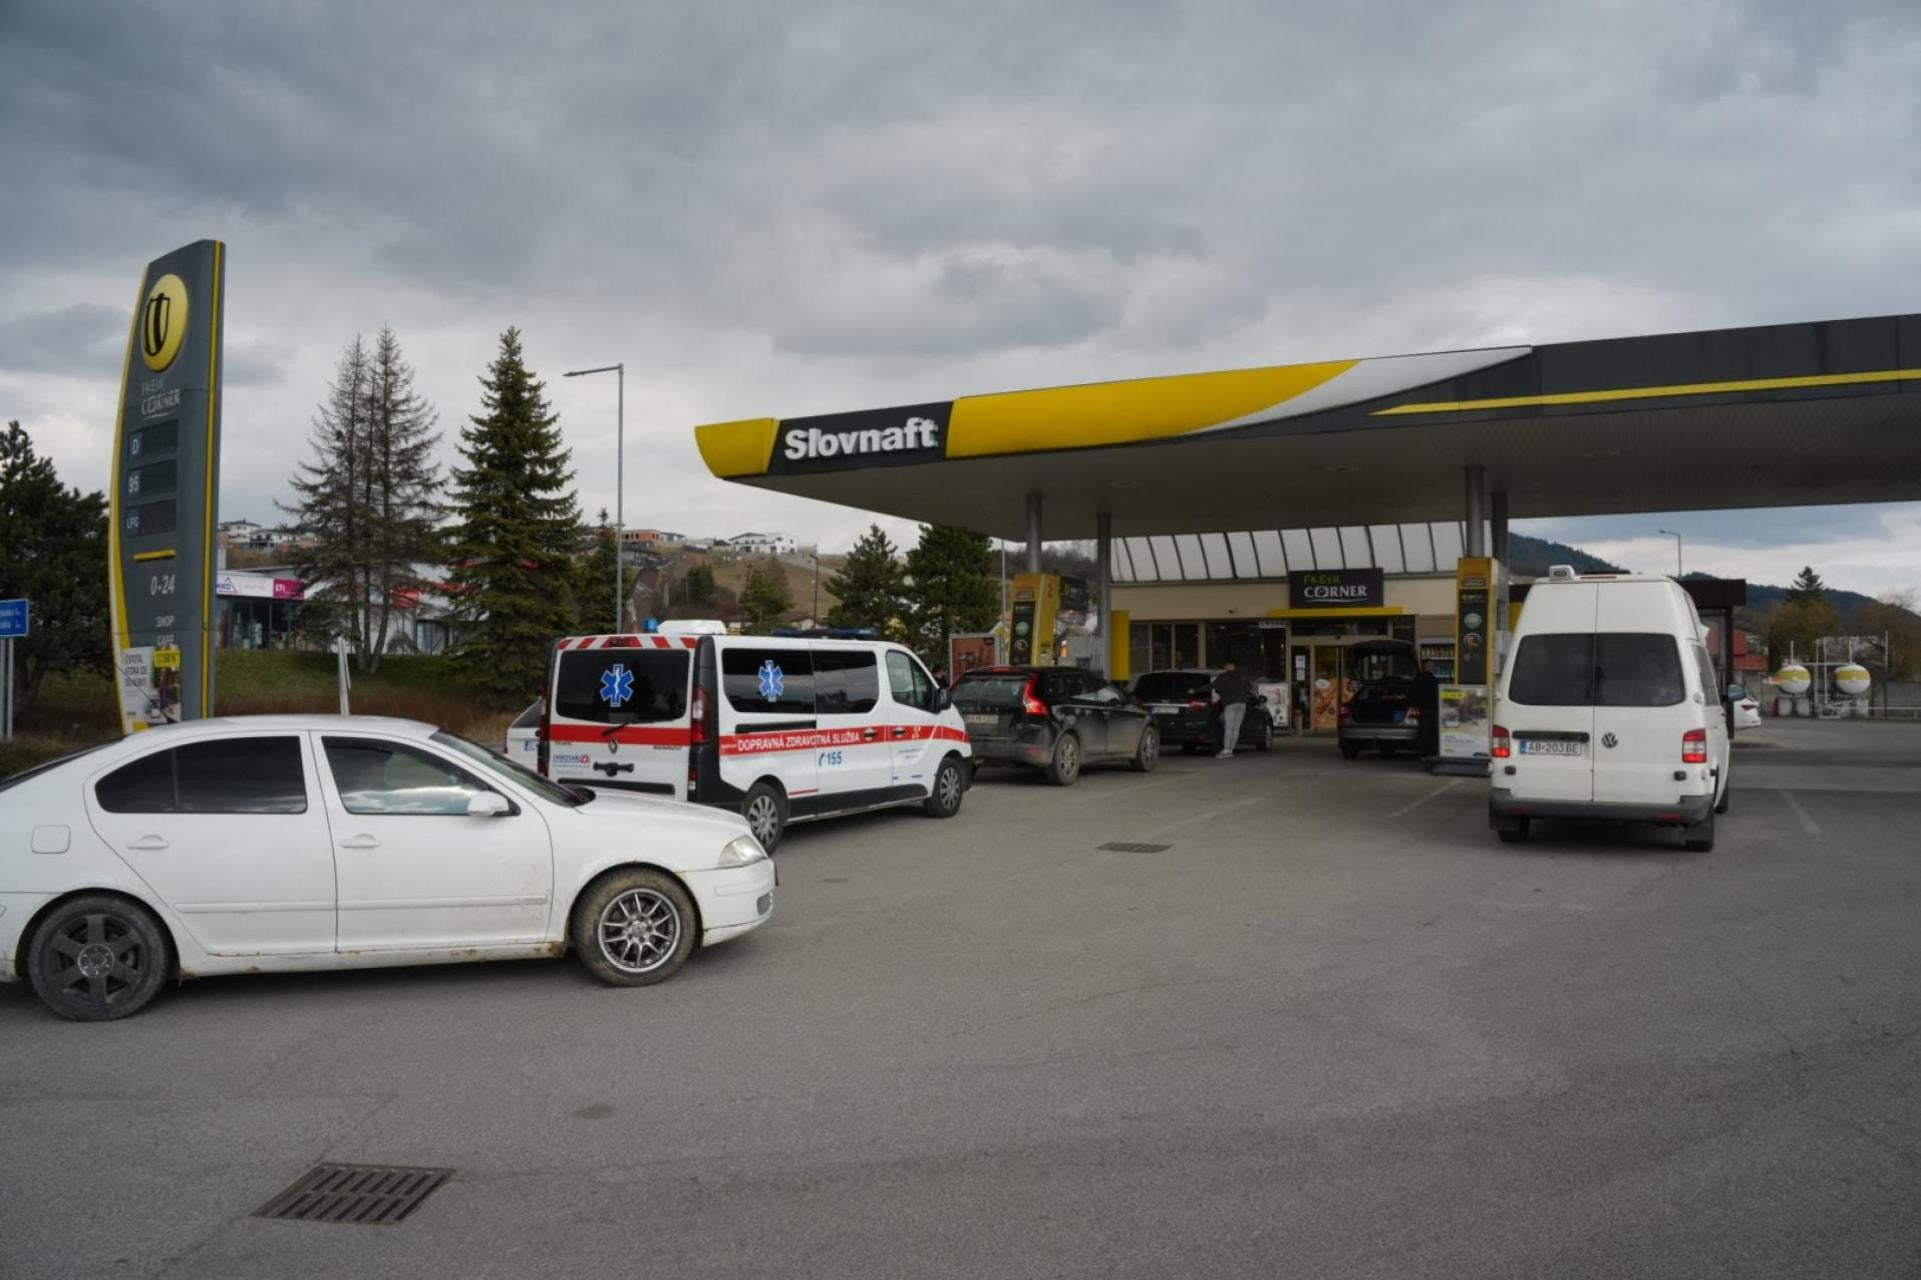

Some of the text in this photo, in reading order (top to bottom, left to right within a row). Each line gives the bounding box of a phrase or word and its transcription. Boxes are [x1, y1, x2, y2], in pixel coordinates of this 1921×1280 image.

[141, 389, 181, 415] CORNER
[784, 416, 939, 460] Slovnaft
[128, 475, 140, 493] 95
[126, 516, 140, 529] LPG
[151, 574, 175, 595] 0-24
[1304, 575, 1340, 585] FRESH
[1303, 585, 1368, 599] CORNER
[156, 615, 175, 628] SHOP
[737, 730, 860, 751] DOPRAVNÁ ZDRAVOTNÁ SLUŽBA
[827, 752, 843, 765] 155
